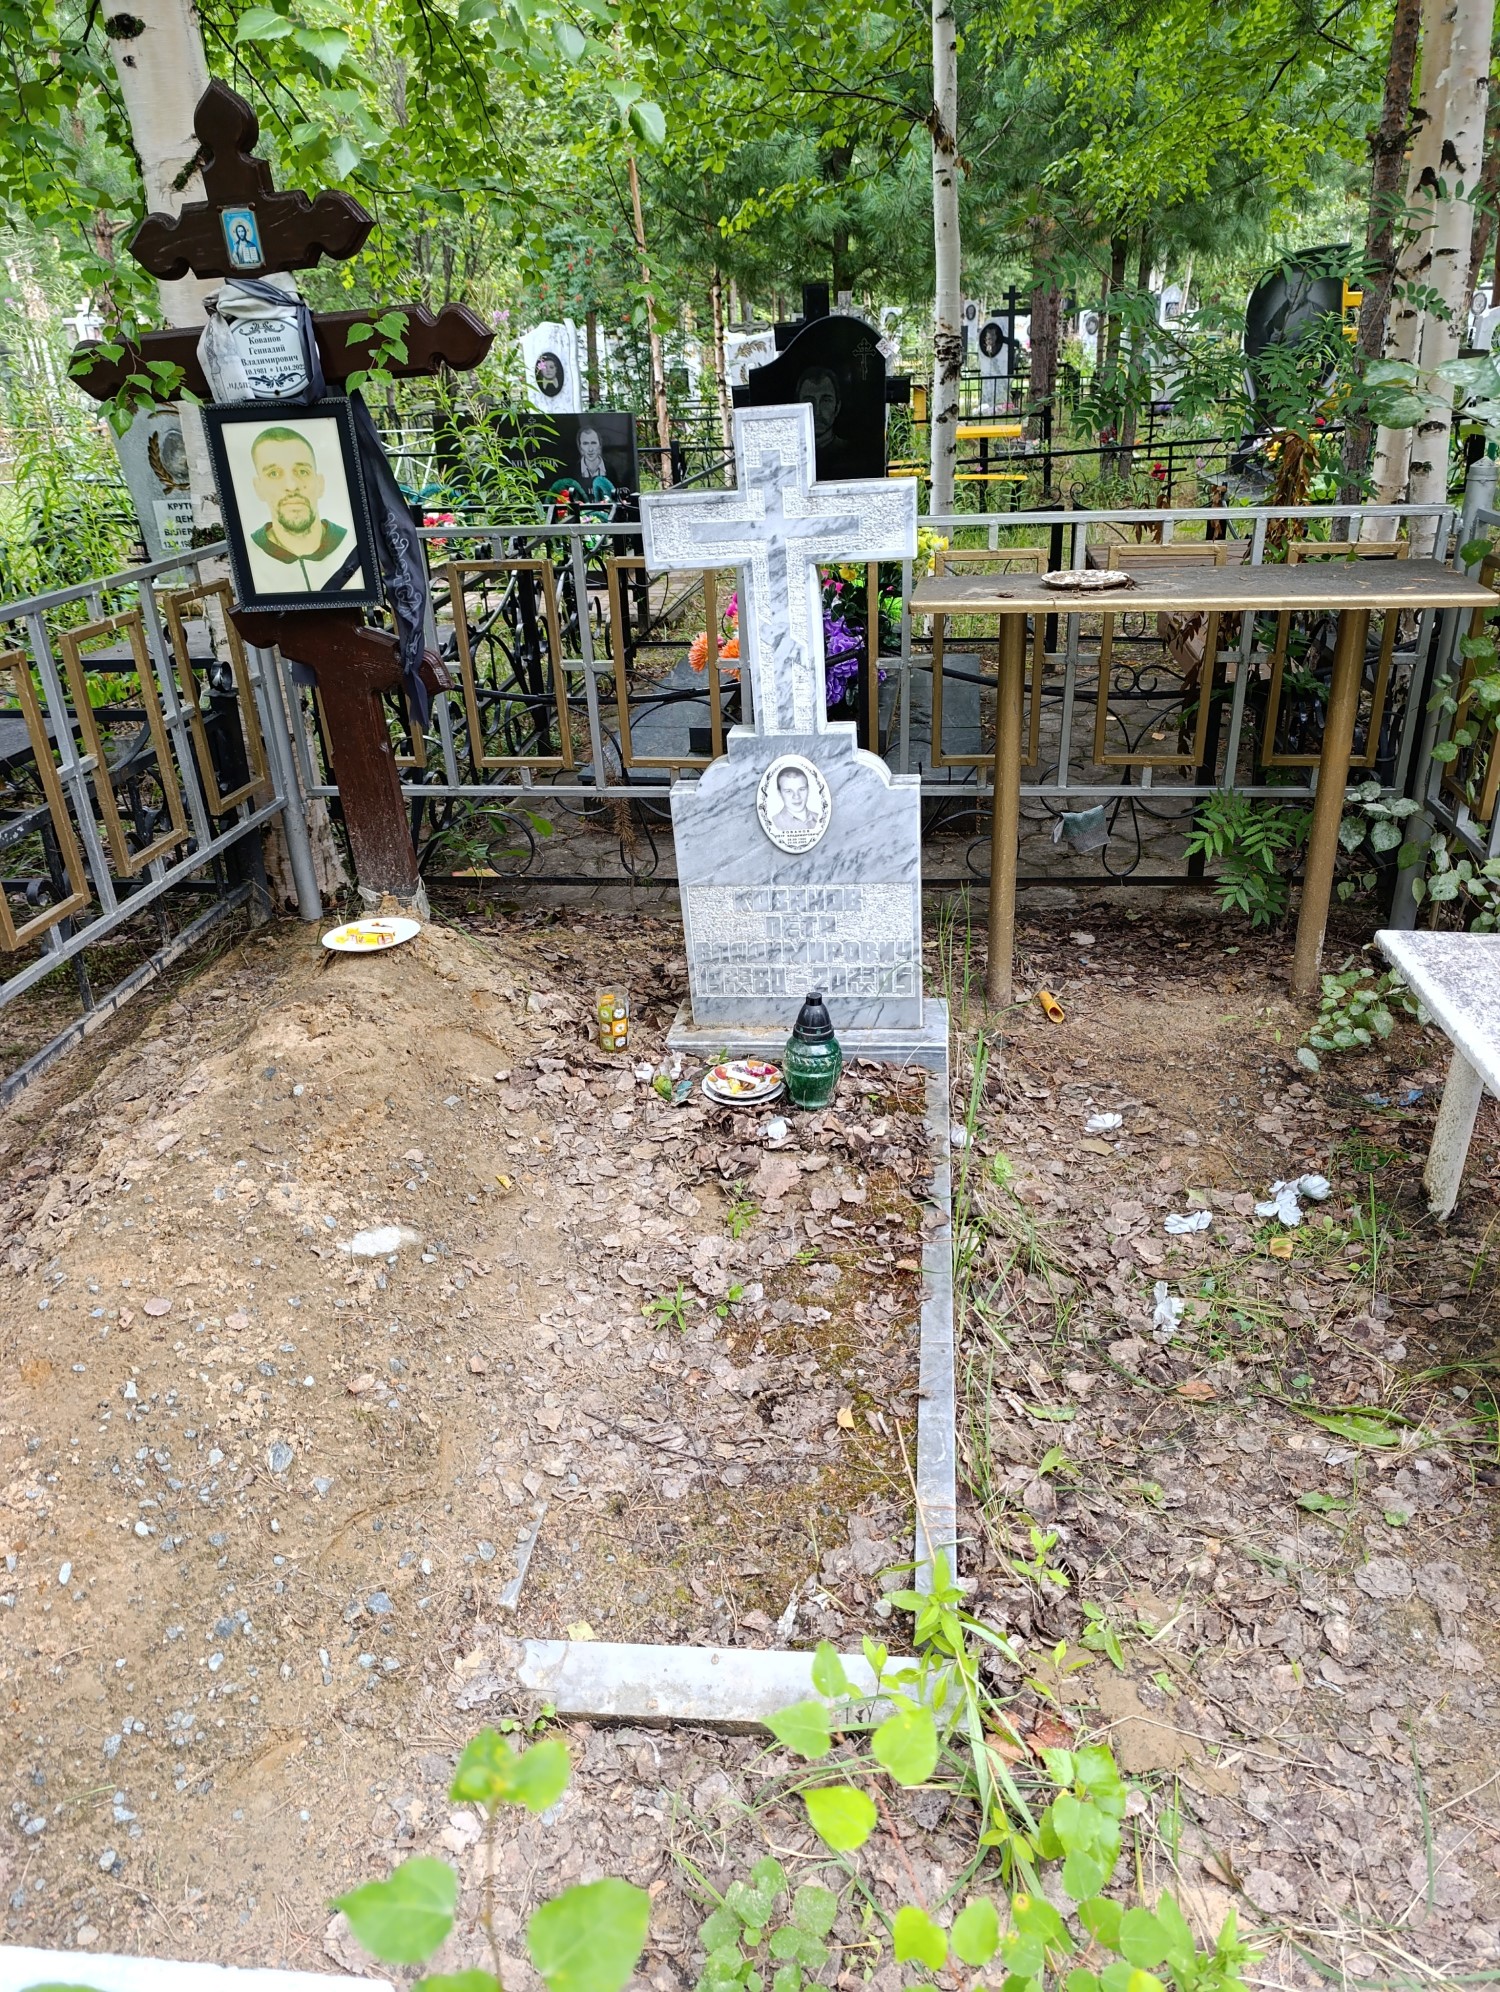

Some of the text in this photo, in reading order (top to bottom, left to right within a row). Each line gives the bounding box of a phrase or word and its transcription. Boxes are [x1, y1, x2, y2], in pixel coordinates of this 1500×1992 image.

[248, 336, 282, 345] Кованов
[248, 344, 286, 355] Геннадий
[240, 354, 299, 367] Владимирович
[733, 888, 863, 912] КОВАНОВ
[765, 915, 837, 938] ПЕТР
[694, 940, 914, 964] ВЛАДИМИРОВИЧ
